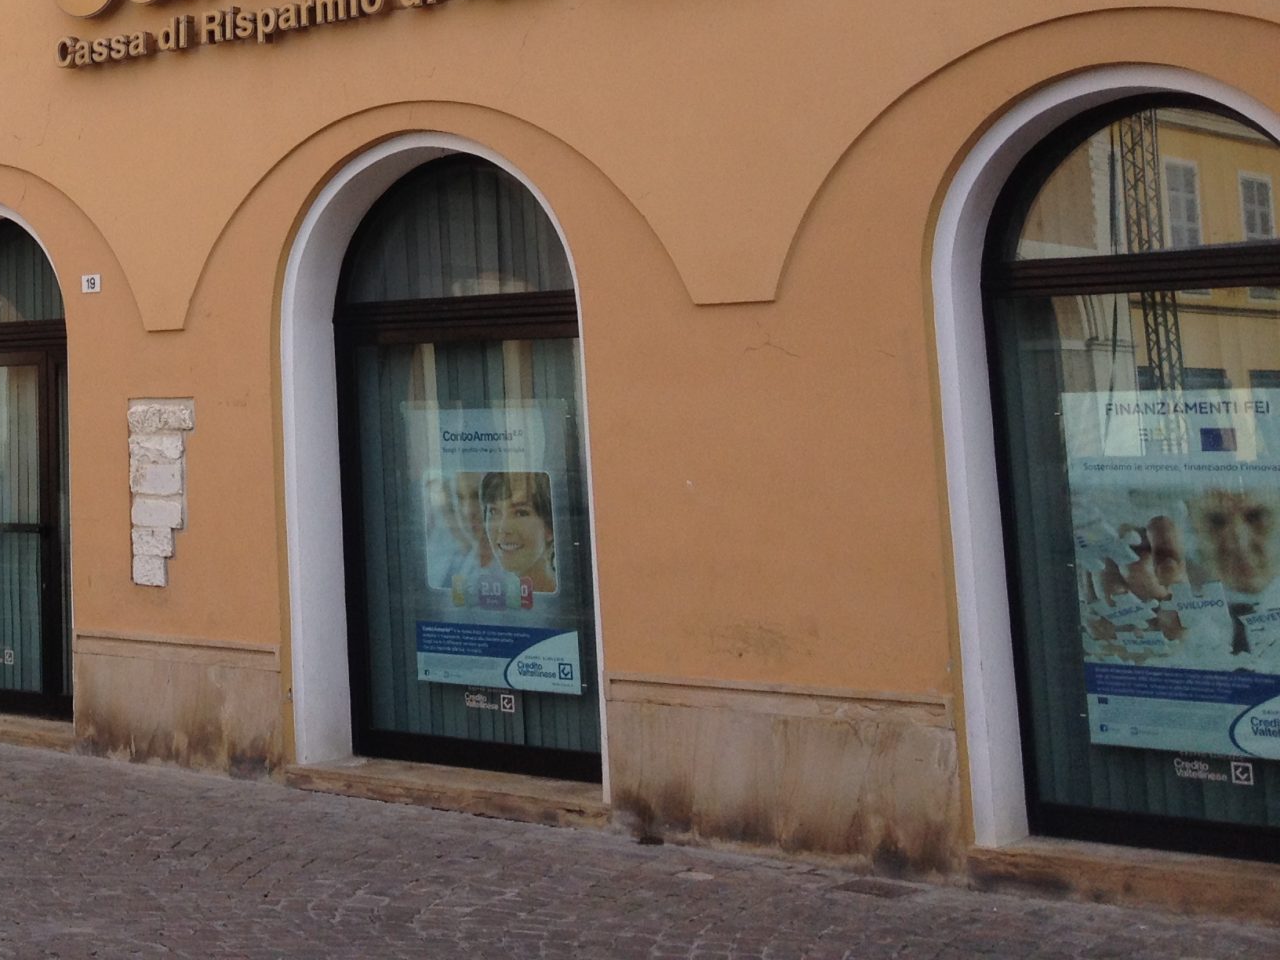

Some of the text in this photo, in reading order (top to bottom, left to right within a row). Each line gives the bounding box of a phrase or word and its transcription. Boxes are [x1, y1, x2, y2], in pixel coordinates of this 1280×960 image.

[56, 29, 148, 69] Cassa
[158, 14, 194, 50] di
[86, 276, 96, 290] 19
[1104, 400, 1270, 416] FINANZIAMENTI FEI
[1083, 462, 1133, 472] Sosteniamo
[1183, 462, 1238, 472] finanziando
[480, 582, 502, 596] 2.0
[1176, 599, 1225, 611] SVILUPPO
[1174, 757, 1209, 771] Credito
